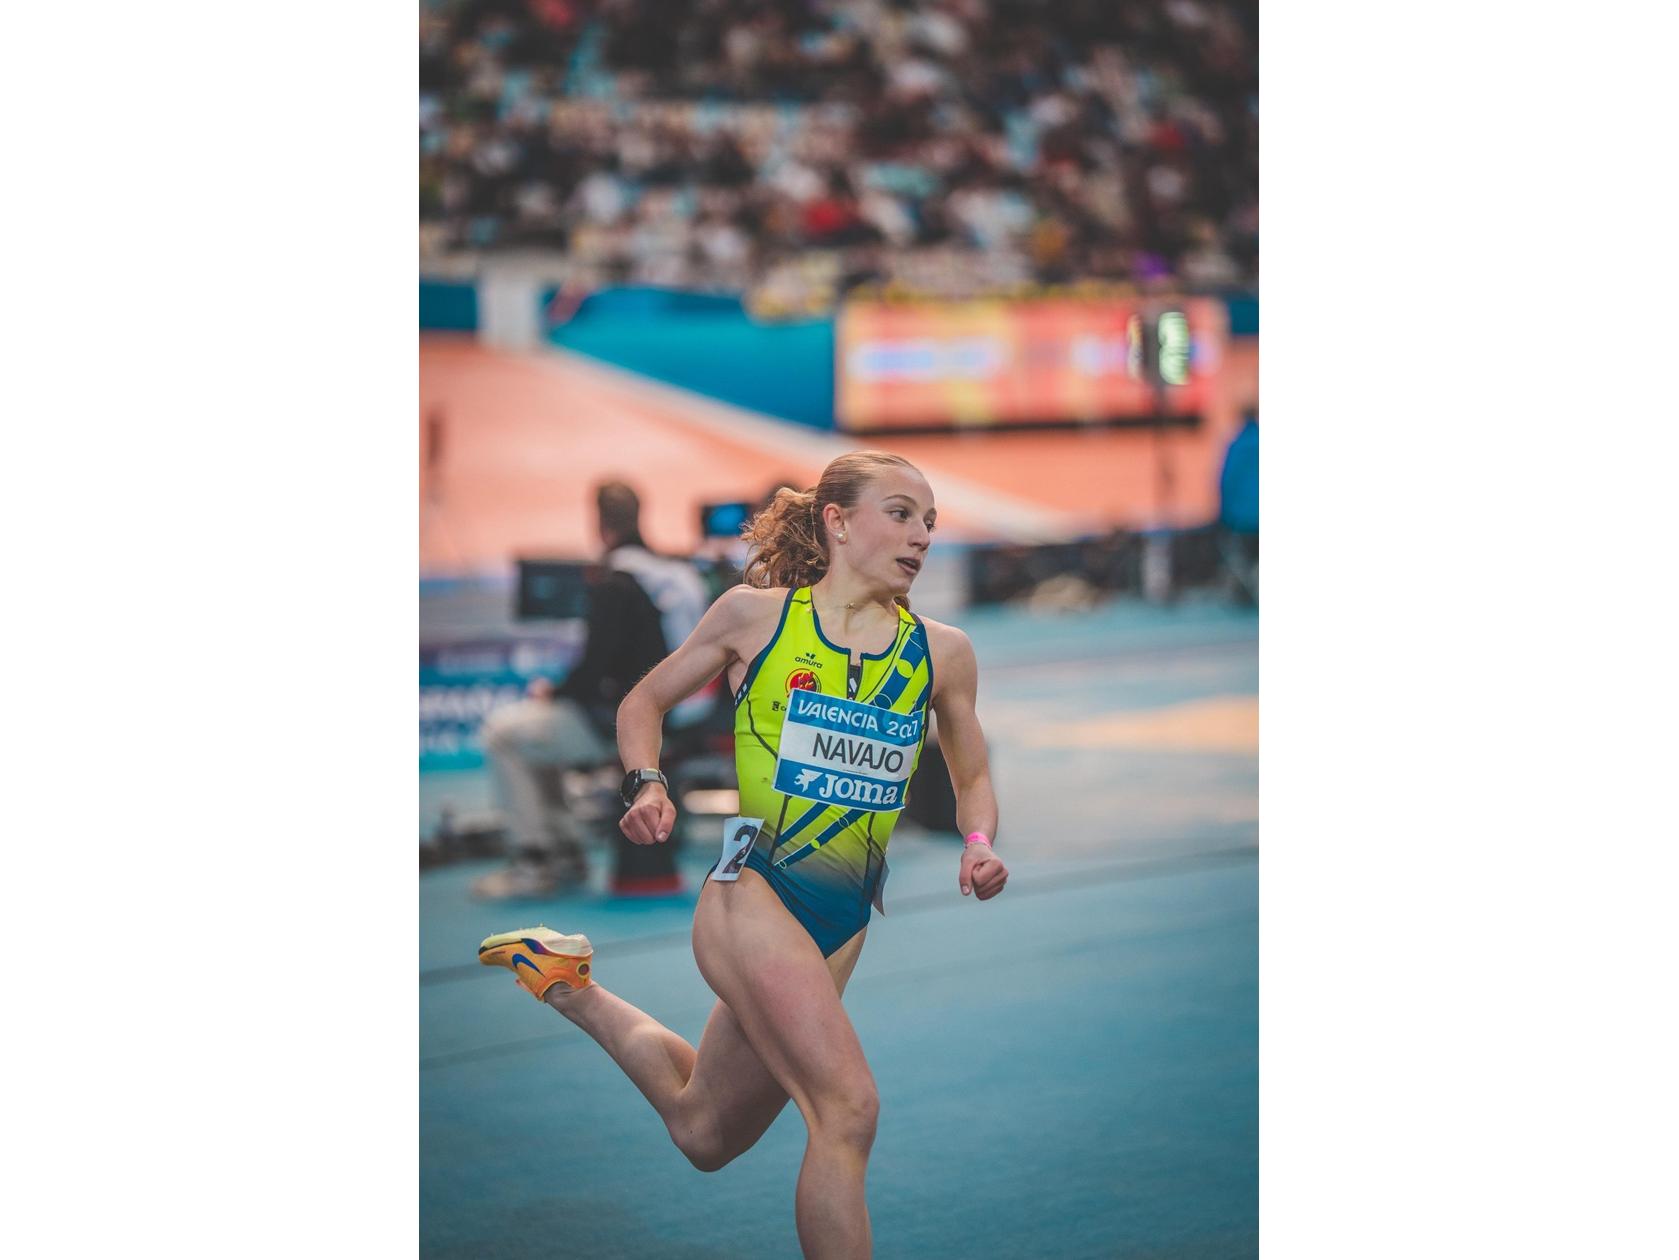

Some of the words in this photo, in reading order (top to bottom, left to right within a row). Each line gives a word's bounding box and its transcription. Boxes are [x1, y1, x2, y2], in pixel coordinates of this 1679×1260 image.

[794, 656, 823, 669] amura
[798, 699, 878, 732] VALENCIA
[812, 733, 904, 773] NAVAJO
[722, 824, 758, 874] 2
